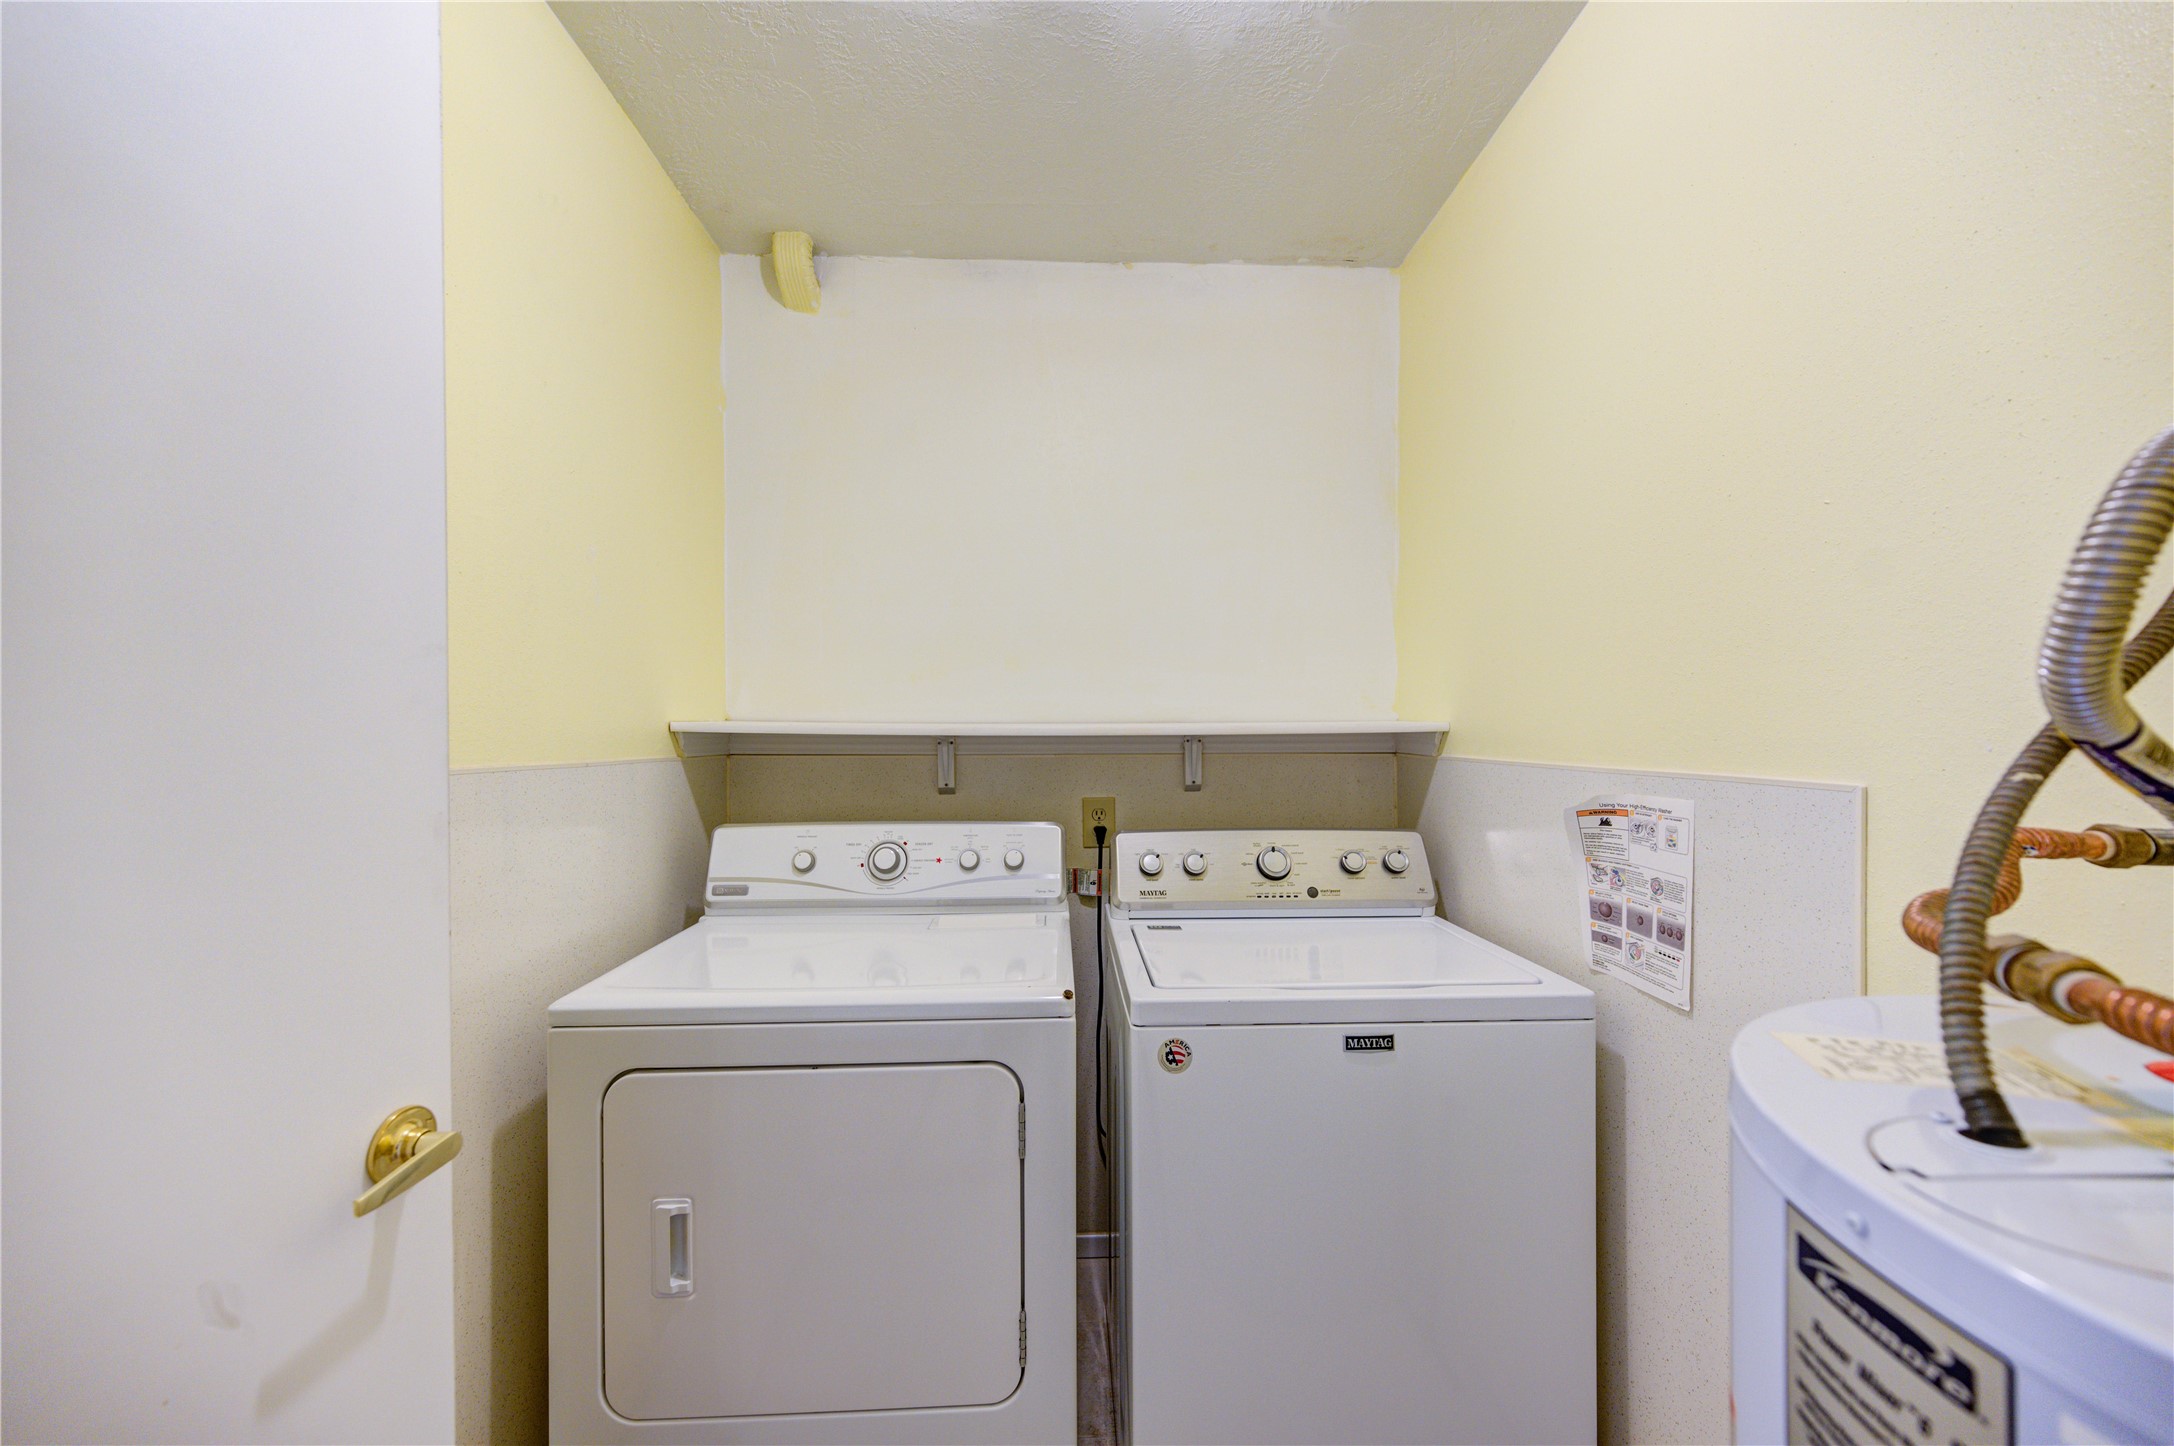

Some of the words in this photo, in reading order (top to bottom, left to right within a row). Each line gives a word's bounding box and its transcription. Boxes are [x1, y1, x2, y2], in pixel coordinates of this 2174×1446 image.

[1139, 889, 1168, 897] MAYTAG
[1164, 1039, 1192, 1058] AMERICA
[1347, 1038, 1393, 1048] MAYTAG
[1800, 1257, 1975, 1404] Kenmore
